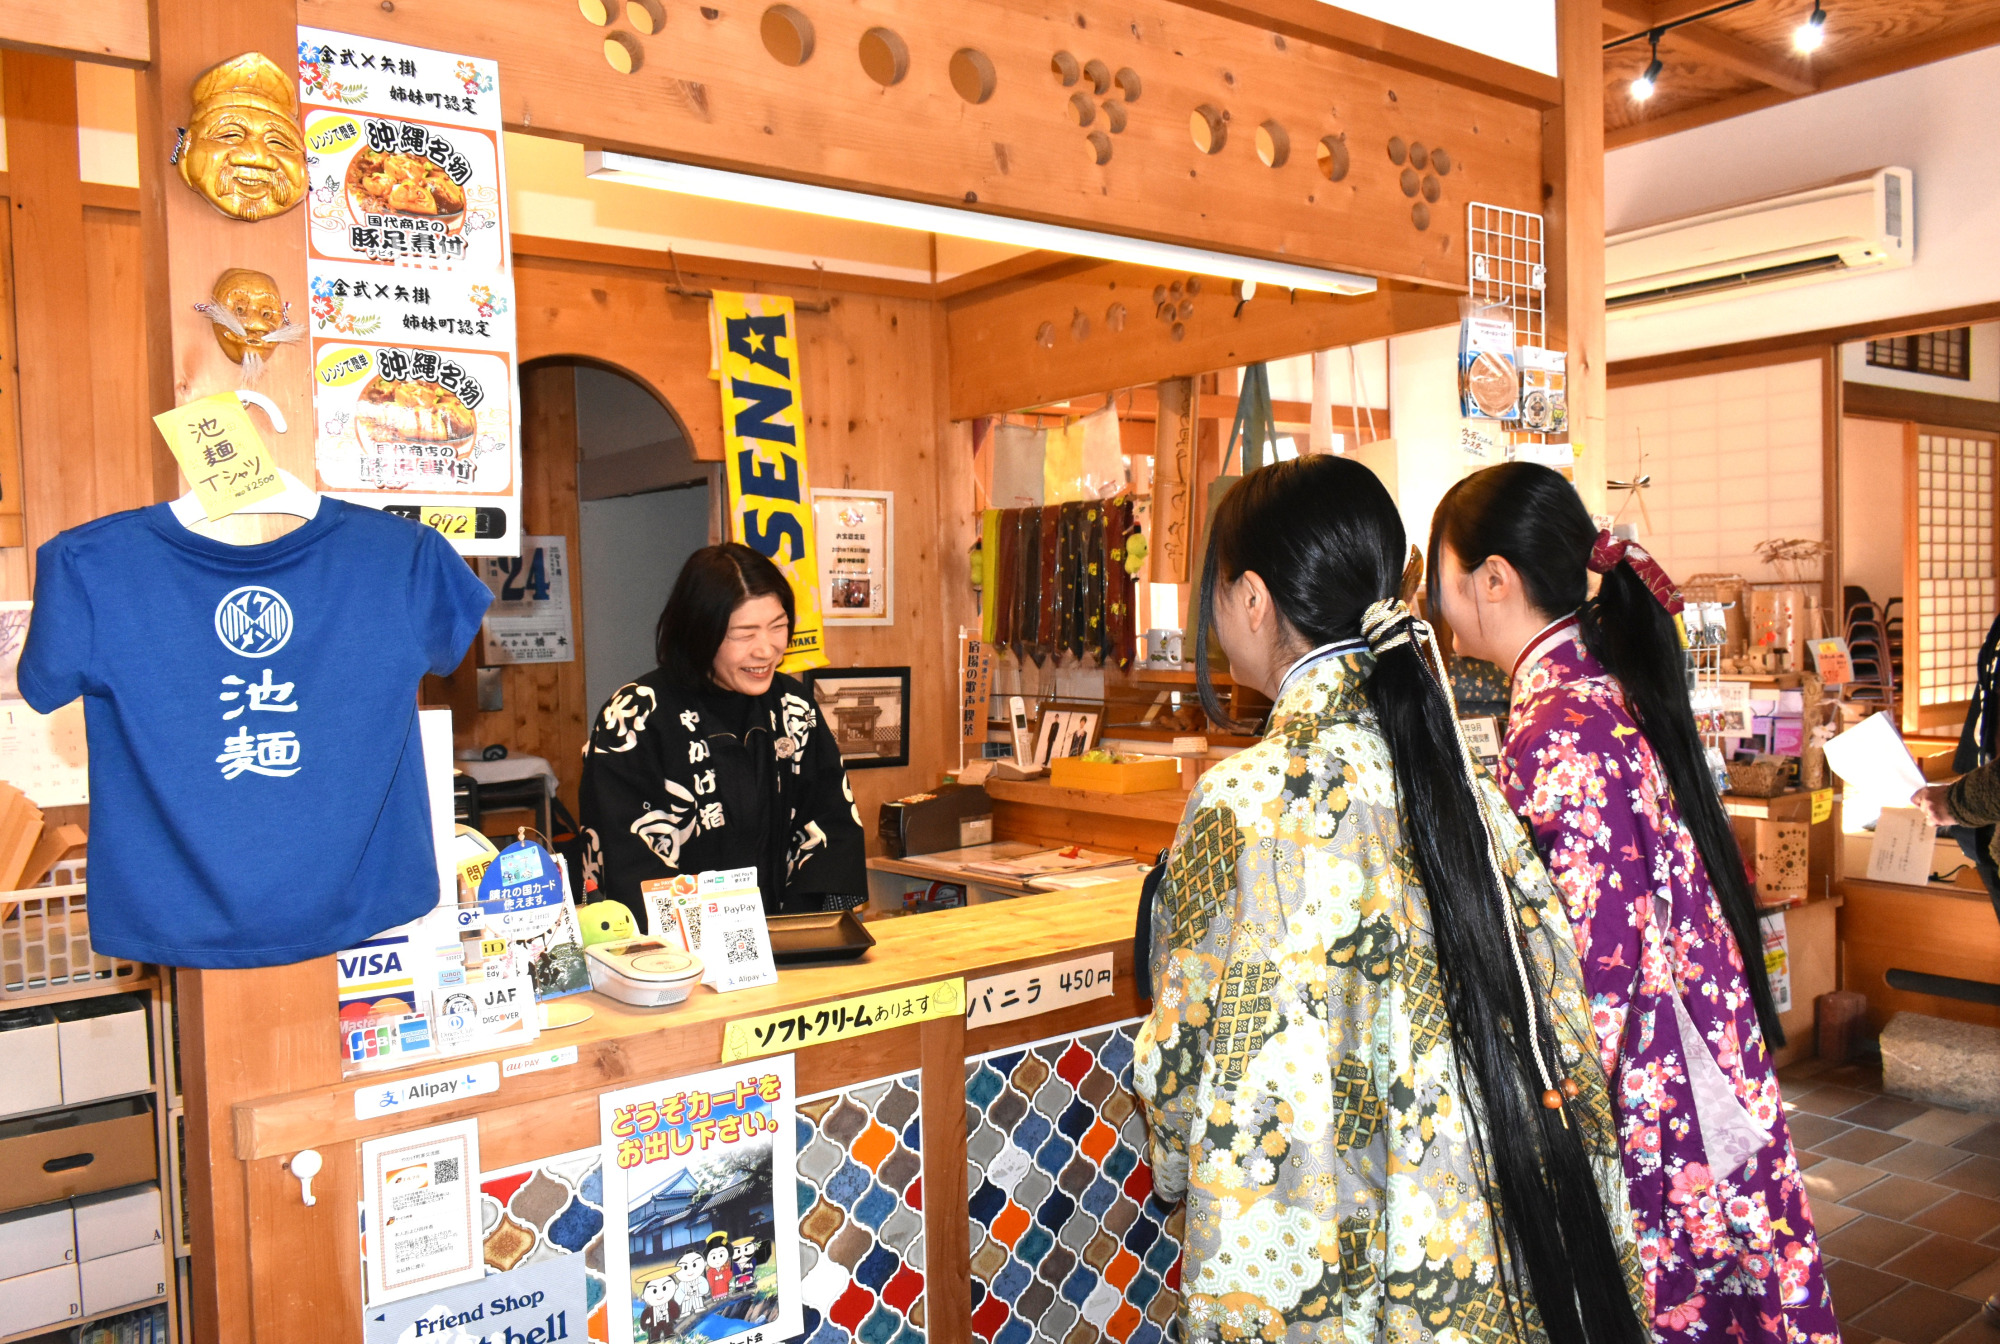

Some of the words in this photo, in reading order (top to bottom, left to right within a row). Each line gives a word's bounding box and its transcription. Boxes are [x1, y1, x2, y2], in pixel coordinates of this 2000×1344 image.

[390, 86, 478, 114] 姉妹町認定
[311, 122, 358, 150] レンジで簡単
[367, 120, 470, 182] 沖縄名物
[367, 215, 444, 233] 国代商店の
[402, 314, 490, 337] 姉妹町認定
[321, 353, 369, 383] レンジで簡単
[378, 350, 481, 406] 沖縄名物
[726, 312, 806, 562] SENA
[498, 547, 550, 601] 24
[215, 668, 302, 780] 池麺
[680, 709, 725, 830] やかげ宿
[489, 880, 556, 900] 晴れの国カード
[503, 894, 547, 911] 使えます。
[723, 904, 756, 915] PayPay
[338, 952, 403, 979] VISA
[486, 970, 500, 978] Edy
[738, 973, 760, 983] Alipay
[485, 988, 517, 1006] JAF
[967, 978, 1042, 1018] バニラ
[1060, 968, 1111, 993] 450円
[482, 1012, 520, 1024] DISCOVER
[506, 1061, 522, 1072] au
[524, 1059, 539, 1068] PAY
[408, 1079, 458, 1100] Alipay
[611, 1074, 781, 1137] どうぞカードを
[617, 1111, 779, 1169] お出し下さい。
[153, 1228, 161, 1241] A
[64, 1249, 73, 1262] C
[156, 1282, 165, 1295] B
[70, 1303, 79, 1315] D
[414, 1304, 485, 1338] Friend
[490, 1289, 545, 1316] Shop
